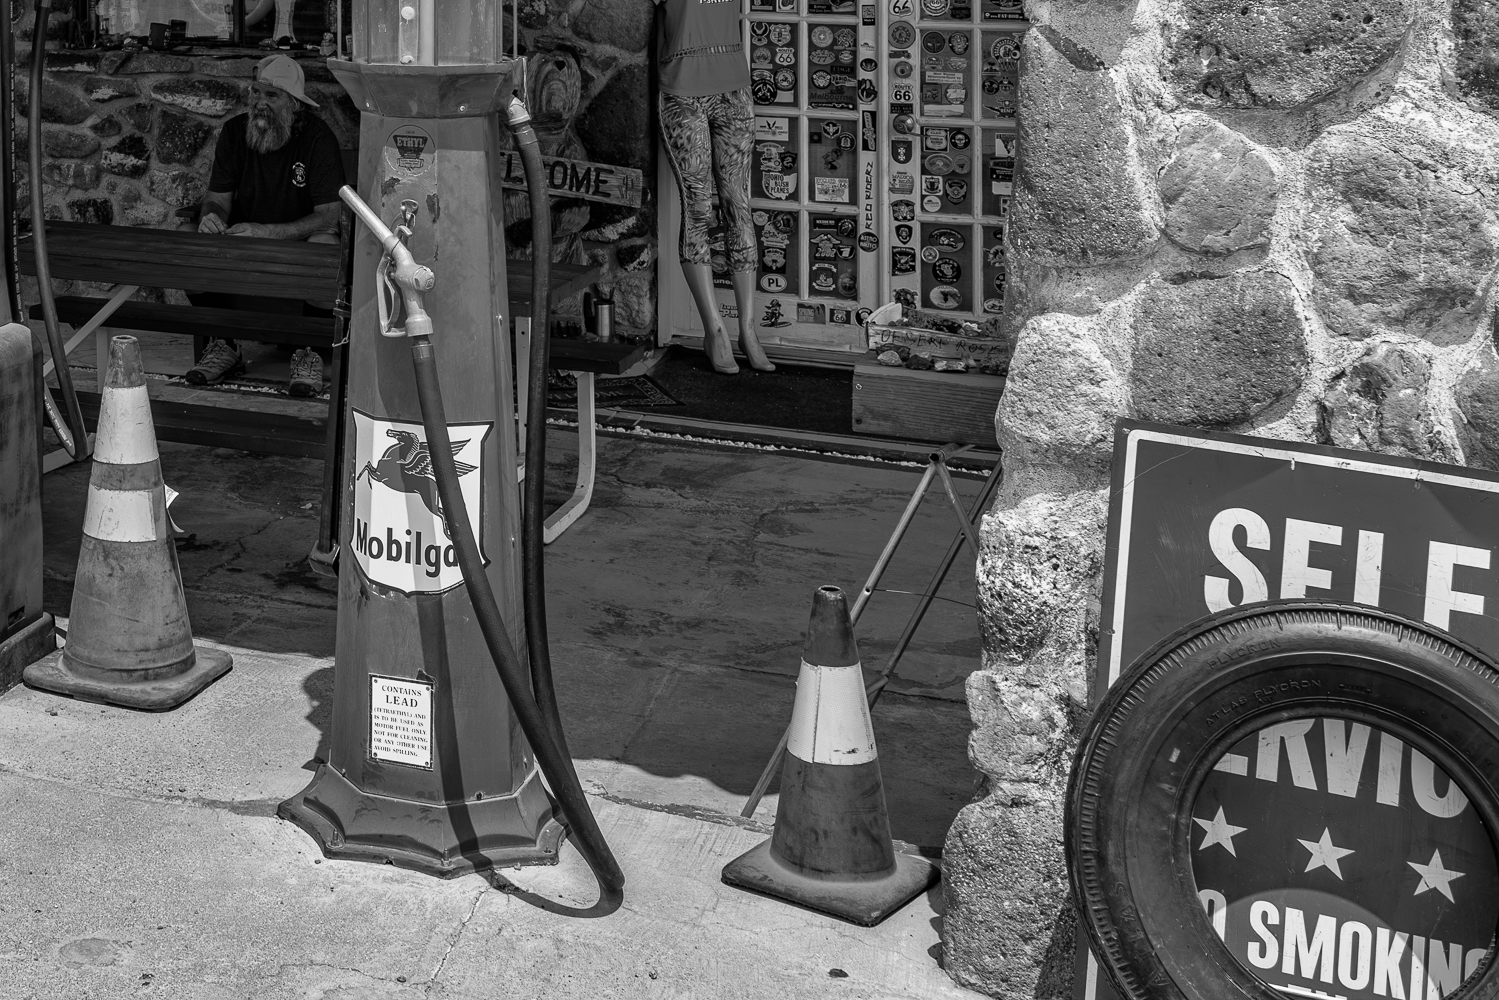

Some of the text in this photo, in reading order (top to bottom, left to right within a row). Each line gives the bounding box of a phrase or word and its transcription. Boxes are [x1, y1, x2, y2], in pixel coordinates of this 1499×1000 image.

[893, 0, 911, 14] 66
[779, 54, 792, 62] 66
[894, 91, 911, 100] 66
[397, 137, 424, 147] ETHYL
[500, 152, 614, 198] LOME
[865, 204, 873, 230] RED
[768, 278, 782, 287] PL
[357, 518, 459, 578] Mobilga
[1207, 639, 1281, 670] PLYCRON
[382, 685, 422, 697] CONTAINS
[386, 694, 418, 708] LEAD
[1205, 697, 1247, 726] ATLAS
[1253, 679, 1321, 698] PLYCRON
[374, 722, 393, 730] MOTOR
